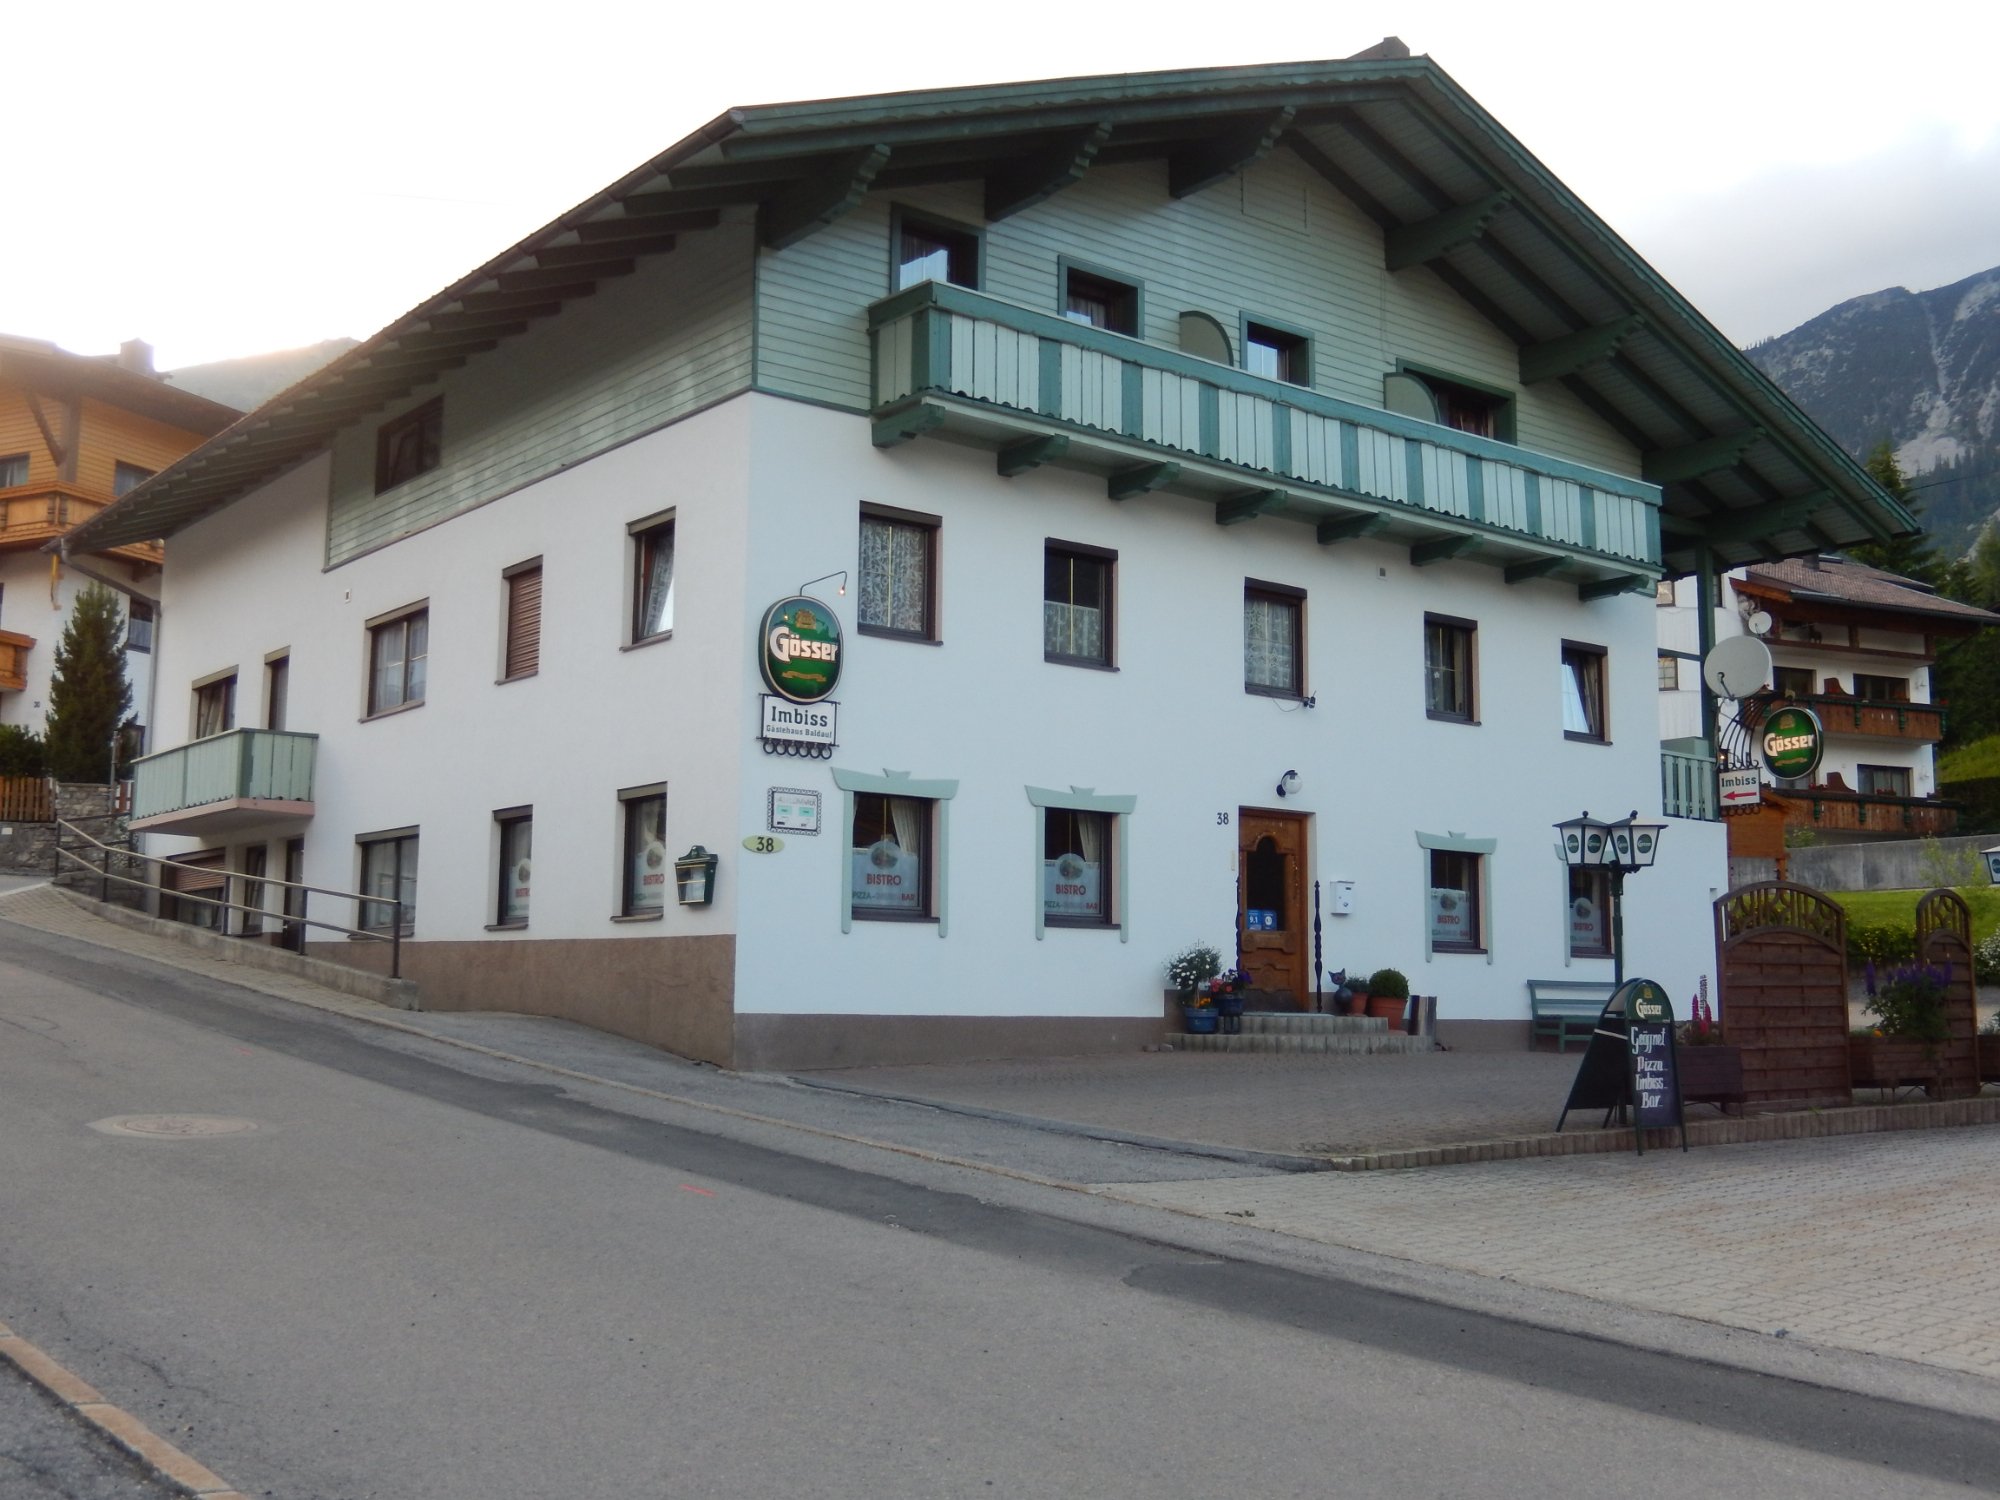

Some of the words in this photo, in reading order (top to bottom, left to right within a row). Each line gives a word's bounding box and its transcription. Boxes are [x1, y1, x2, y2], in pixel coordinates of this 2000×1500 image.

[769, 626, 839, 662] Gösser
[771, 705, 828, 727] Imbiss
[1763, 732, 1814, 757] Gösser
[1721, 775, 1757, 788] Imbiss
[1216, 812, 1229, 825] 38
[756, 836, 775, 853] 38
[866, 873, 902, 886] BISTRO
[1055, 884, 1087, 896] BISTRO
[1636, 998, 1662, 1019] Gösser
